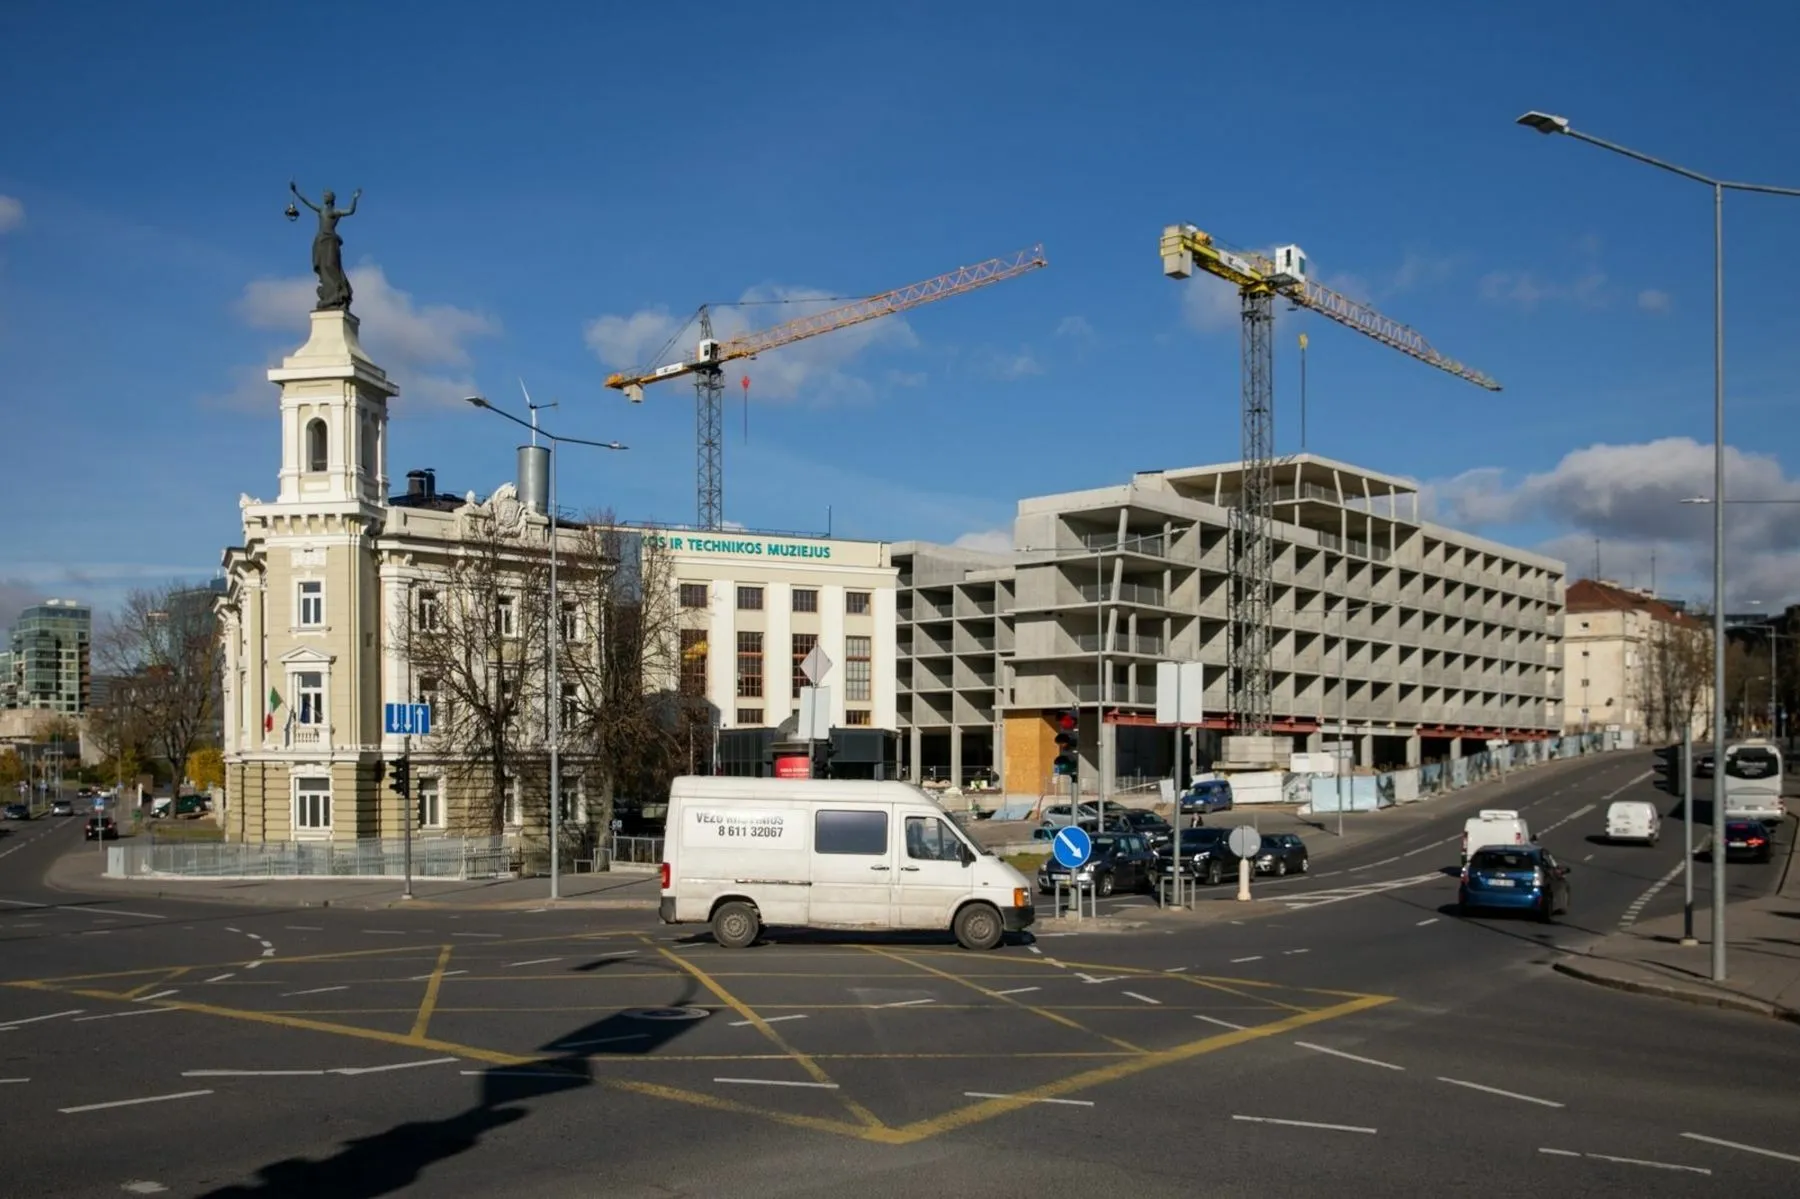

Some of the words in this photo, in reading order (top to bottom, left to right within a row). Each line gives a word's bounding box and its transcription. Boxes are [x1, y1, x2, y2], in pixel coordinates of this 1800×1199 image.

[670, 537, 683, 551] IR
[687, 538, 763, 555] TECHNIKOS
[767, 543, 831, 558] MUZIEJUS
[718, 825, 725, 837] 8
[728, 826, 747, 837] 611
[750, 826, 784, 838] 32067
